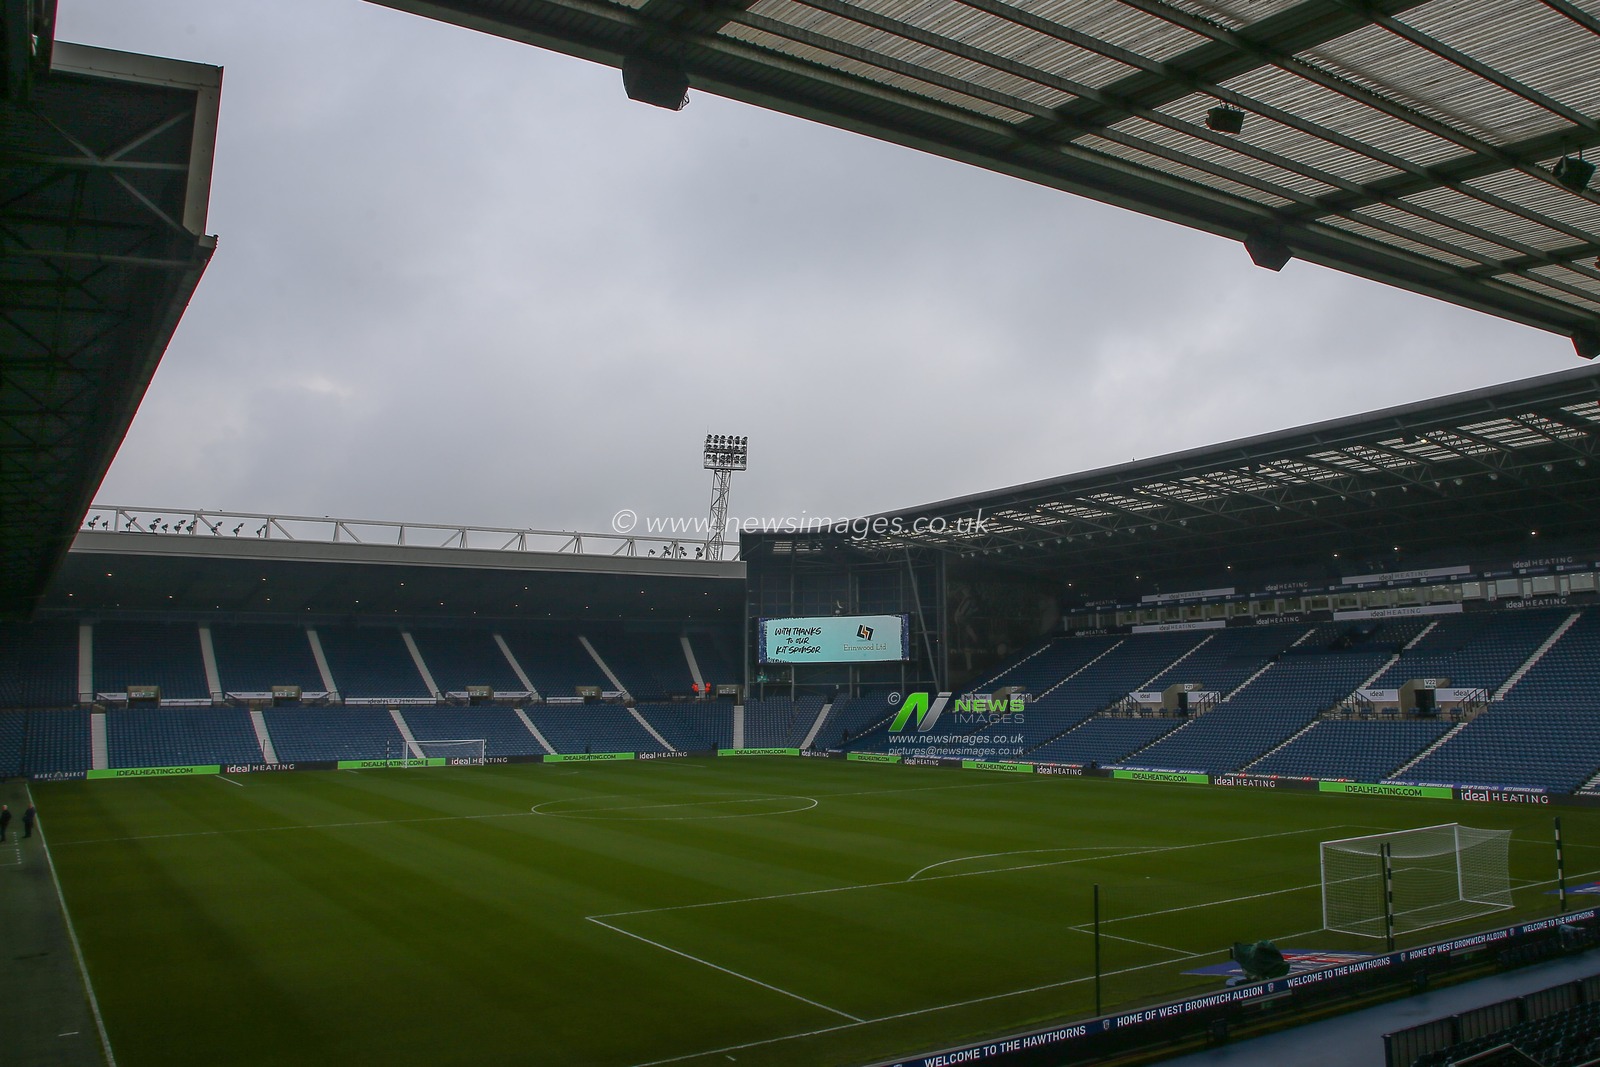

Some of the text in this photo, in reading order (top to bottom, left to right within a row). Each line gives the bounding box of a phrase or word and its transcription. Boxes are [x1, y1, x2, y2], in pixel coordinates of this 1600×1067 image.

[1513, 556, 1573, 568] ideal HEATING
[1379, 571, 1429, 581] ideal HEATING
[1279, 581, 1308, 590] HEATING
[1506, 597, 1567, 609] ideal HEATING
[1371, 608, 1421, 618] ideal HEATING
[1256, 615, 1299, 625] ideal HEATING
[775, 626, 822, 636] WITH THANKS
[789, 646, 821, 655] SPONSOR
[876, 643, 887, 651] Ltd
[1370, 690, 1384, 698] ideal
[1453, 689, 1469, 697] ideal
[564, 753, 616, 761] IDEALHEATING.COM
[639, 751, 656, 760] ideal
[361, 760, 424, 768] IDEALHATIN.COM
[904, 756, 917, 764] ideal
[917, 758, 940, 766] HEATING
[116, 767, 193, 777] IDEALHEATING.COM
[227, 763, 295, 774] ideal HEATING
[976, 763, 1018, 772] IDEALHEATING.COM
[1037, 765, 1052, 775] ideal
[1053, 767, 1083, 776] HEATING
[64, 770, 85, 778] DARCY
[1132, 773, 1188, 783] IDEALHEATING.COM
[1214, 776, 1276, 789] ideal HEATING
[1345, 785, 1422, 797] IDEALHEATING.COM
[1461, 789, 1548, 804] ideal HEATING
[1523, 920, 1548, 933] WELCOME
[1548, 919, 1555, 927] TO
[1566, 910, 1594, 924] HAWTHORNS
[1410, 930, 1507, 959] HOME OF WEST BROMWICH ALBION
[1287, 972, 1322, 988] WELCOME
[1324, 969, 1333, 979] TO
[1335, 966, 1348, 977] THE
[1349, 956, 1390, 973] HAWTHORNS
[1117, 986, 1263, 1027] HOME OF WEST BROMWICH ALBION
[925, 1025, 1086, 1067] WELCOME TO THE HAWTHORNS
